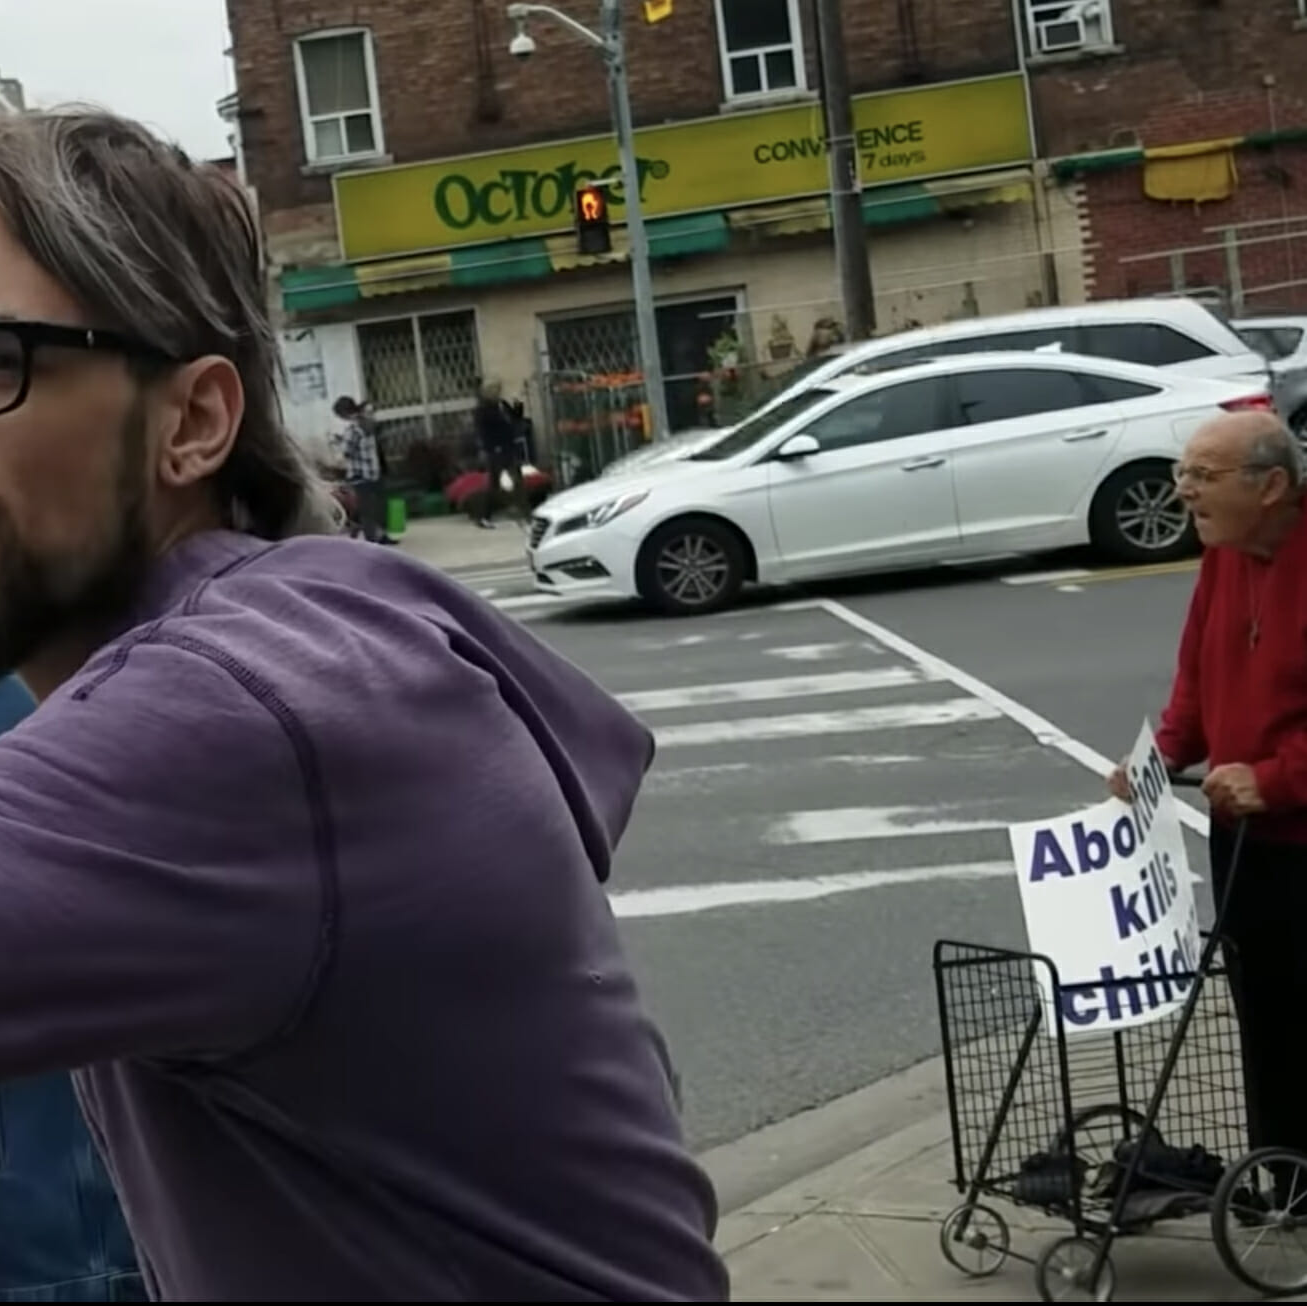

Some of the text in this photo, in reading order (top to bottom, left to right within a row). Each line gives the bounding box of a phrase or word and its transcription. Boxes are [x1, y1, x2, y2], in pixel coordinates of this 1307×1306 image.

[754, 120, 923, 164] CONVIENCE
[861, 150, 926, 170] 7 days
[1029, 746, 1168, 883] Abortion
[1109, 850, 1179, 940] kills
